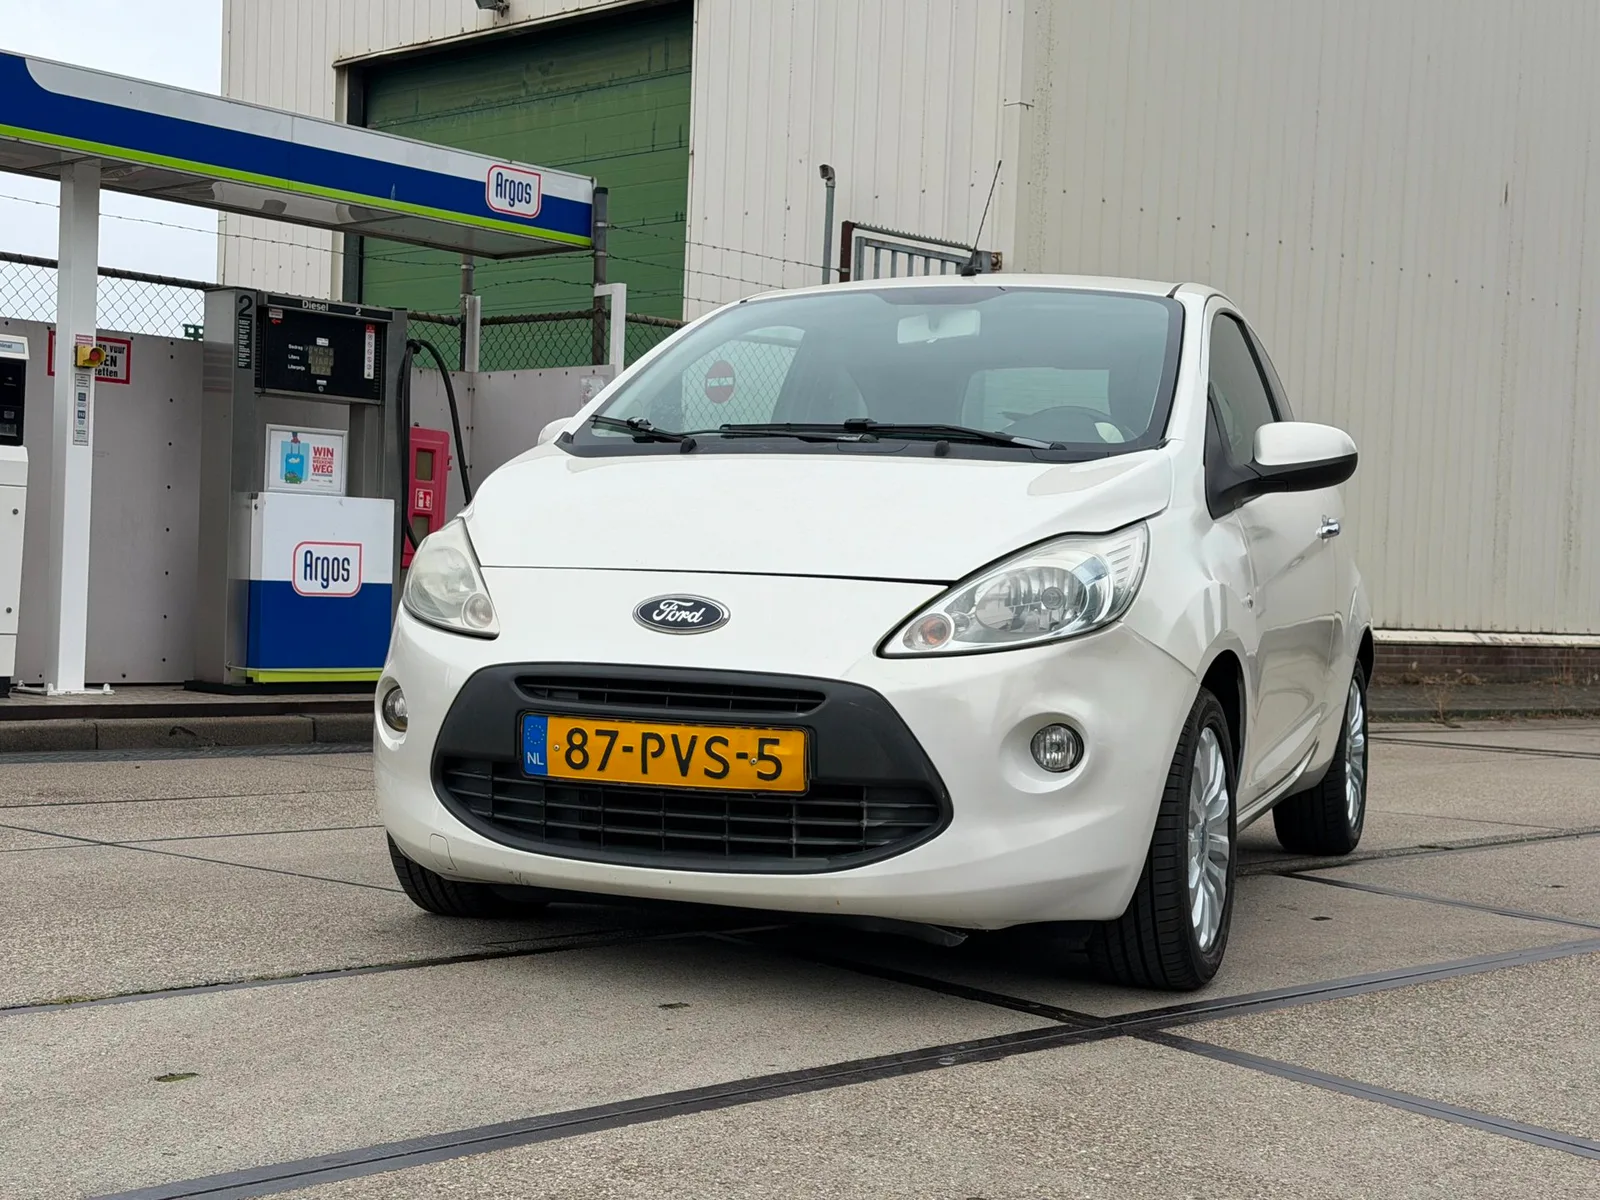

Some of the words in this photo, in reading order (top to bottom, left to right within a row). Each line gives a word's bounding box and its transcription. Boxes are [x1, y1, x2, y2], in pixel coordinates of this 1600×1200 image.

[495, 171, 532, 208] Argos
[238, 294, 253, 318] 2
[302, 300, 329, 312] Diesel
[355, 307, 362, 316] 2
[312, 446, 334, 458] WIN
[312, 464, 333, 474] WEG
[303, 549, 351, 590] Argos
[652, 599, 707, 624] Ford
[526, 751, 545, 766] NL
[564, 727, 784, 782] 87-PVS-5
